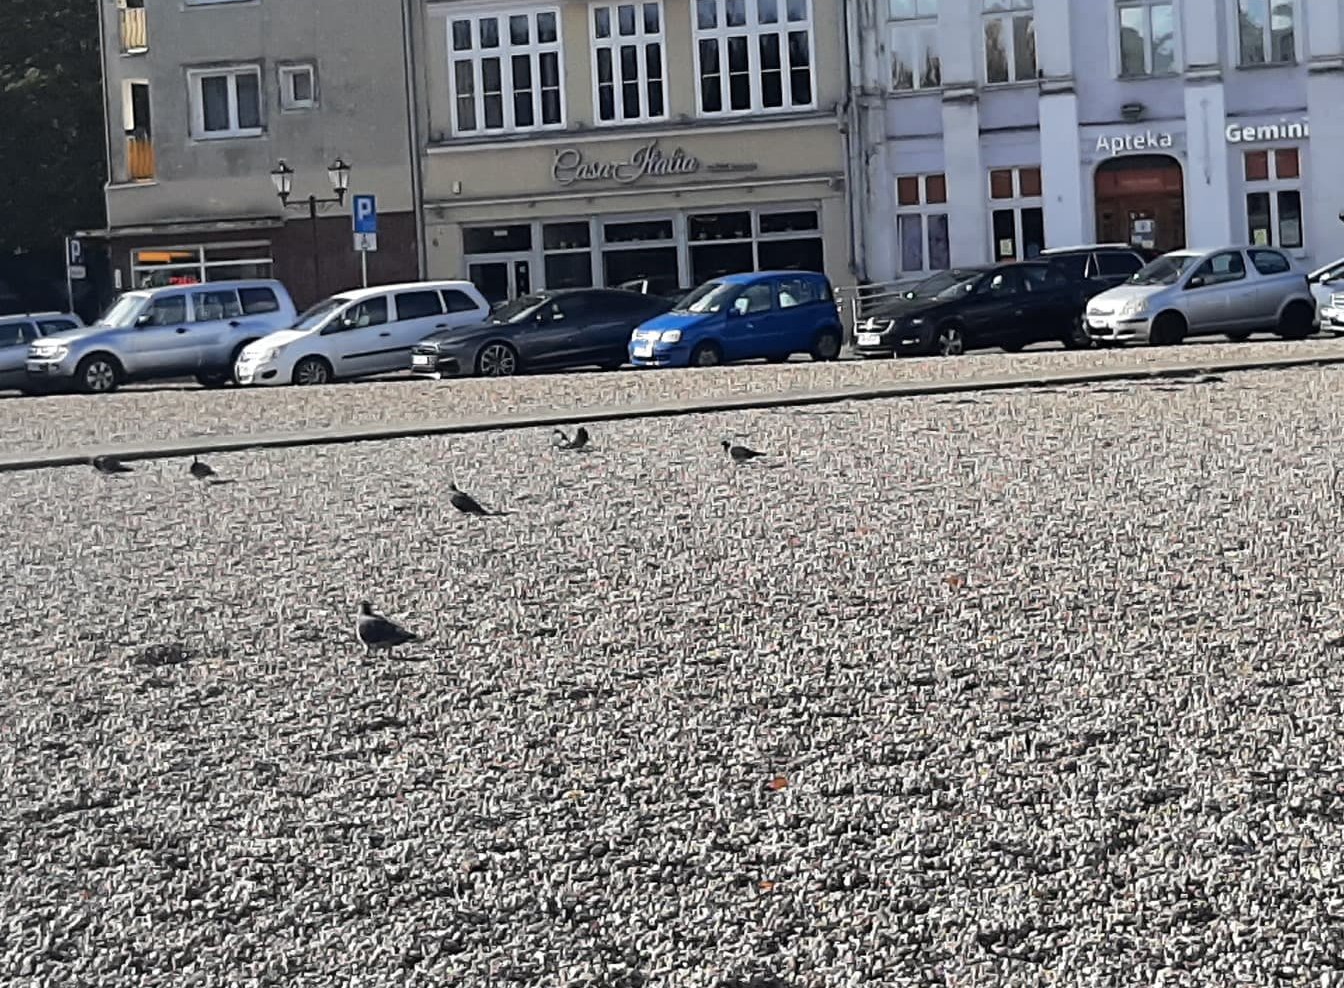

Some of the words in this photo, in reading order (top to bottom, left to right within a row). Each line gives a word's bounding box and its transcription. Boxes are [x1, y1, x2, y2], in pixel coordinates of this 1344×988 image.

[1096, 129, 1172, 155] Apteka
[1225, 116, 1310, 143] Gemini
[552, 147, 616, 186] Casa
[611, 139, 699, 184] Italia
[357, 197, 372, 220] P
